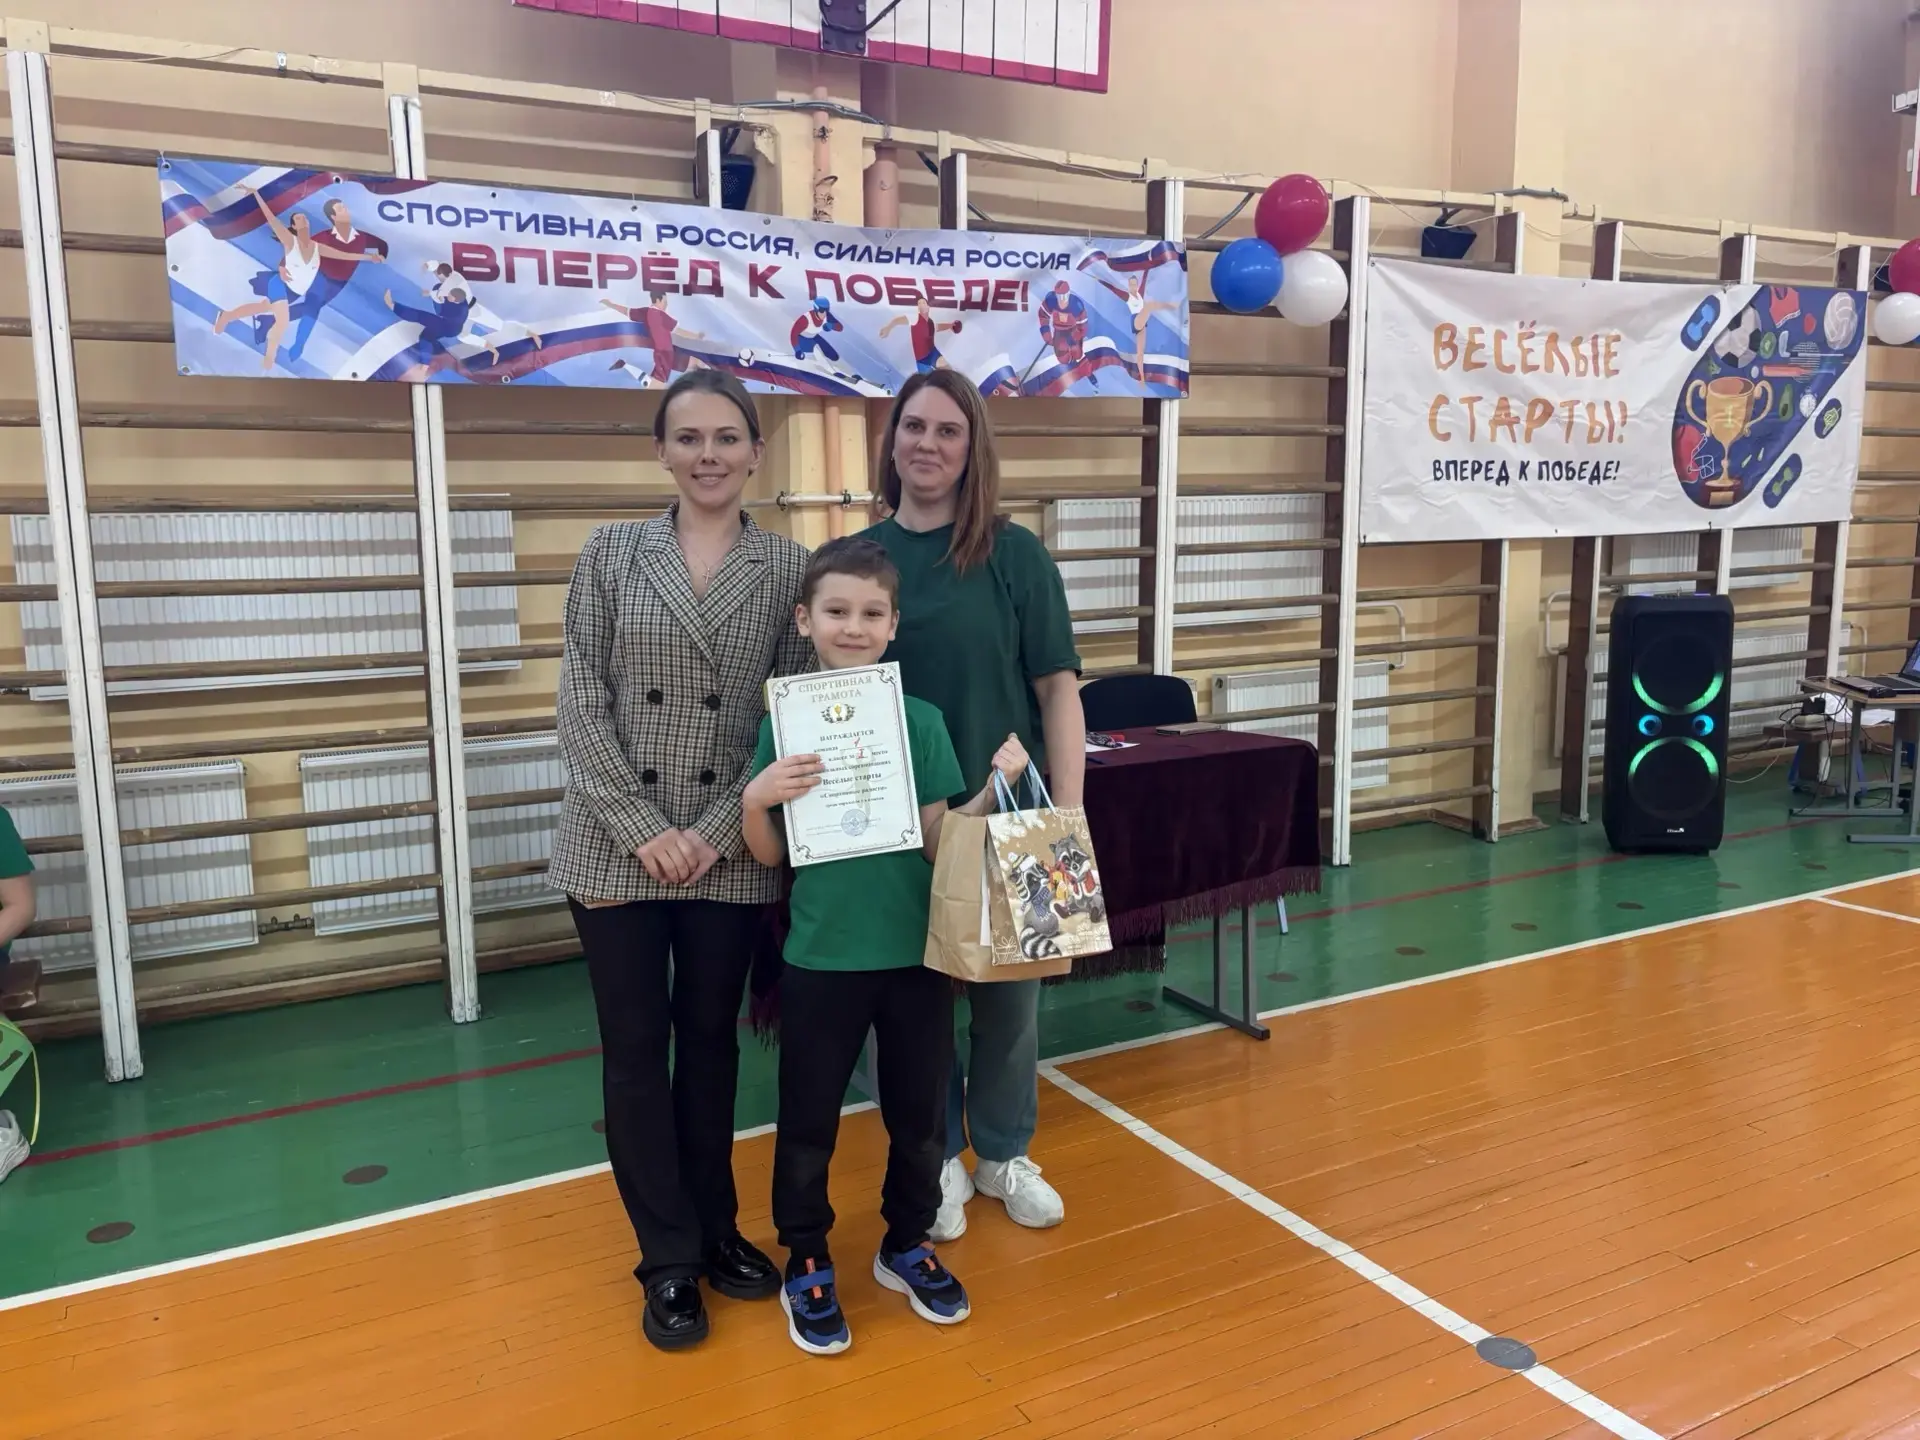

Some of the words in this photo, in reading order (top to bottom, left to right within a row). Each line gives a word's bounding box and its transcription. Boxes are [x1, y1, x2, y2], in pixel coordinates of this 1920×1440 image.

[377, 199, 642, 242] СПОРТИВНАЯ
[656, 223, 800, 260] РОССИЯ,
[814, 240, 955, 267] СИЛЬНАЯ
[965, 249, 1071, 271] РОССИЯ
[452, 241, 724, 298] ВПЕРЁД
[749, 262, 785, 300] К
[805, 269, 1030, 312] ПОБЕДЕ!
[1433, 319, 1622, 378] ВЕСЁЛЫЕ
[1428, 394, 1628, 444] СТАРТЫ!
[1432, 459, 1510, 487] ВПЕРЕД
[1519, 460, 1530, 481] К
[1537, 460, 1621, 487] ПОБЕДЕ!
[798, 675, 873, 694] СПОРТИВНАЯ
[811, 688, 862, 703] ГРАМОТА
[819, 729, 875, 742] НАГРАЖДАЕТСЯ
[822, 776, 853, 786] Весёлые
[854, 772, 882, 782] старты
